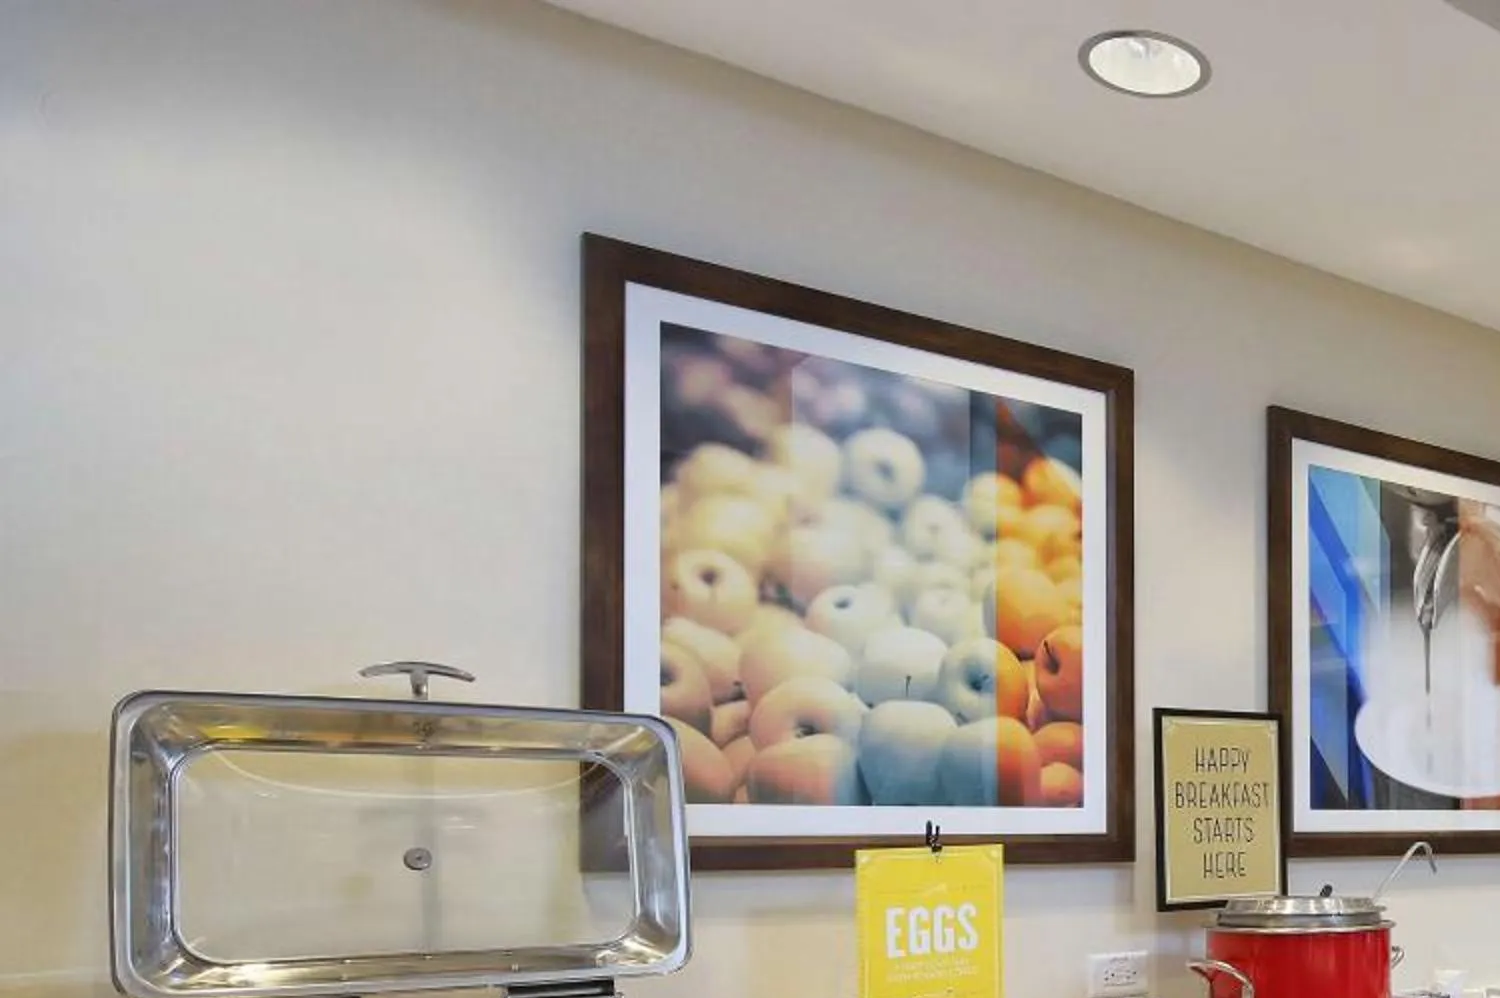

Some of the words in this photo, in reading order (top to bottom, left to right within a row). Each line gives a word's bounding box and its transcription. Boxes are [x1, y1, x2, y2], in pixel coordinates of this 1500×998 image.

[1194, 747, 1251, 773] HAPPY
[1174, 781, 1270, 809] BREAKFAST
[1193, 817, 1254, 844] STARTS
[1203, 851, 1247, 879] HERE
[885, 901, 980, 960] EGGS
